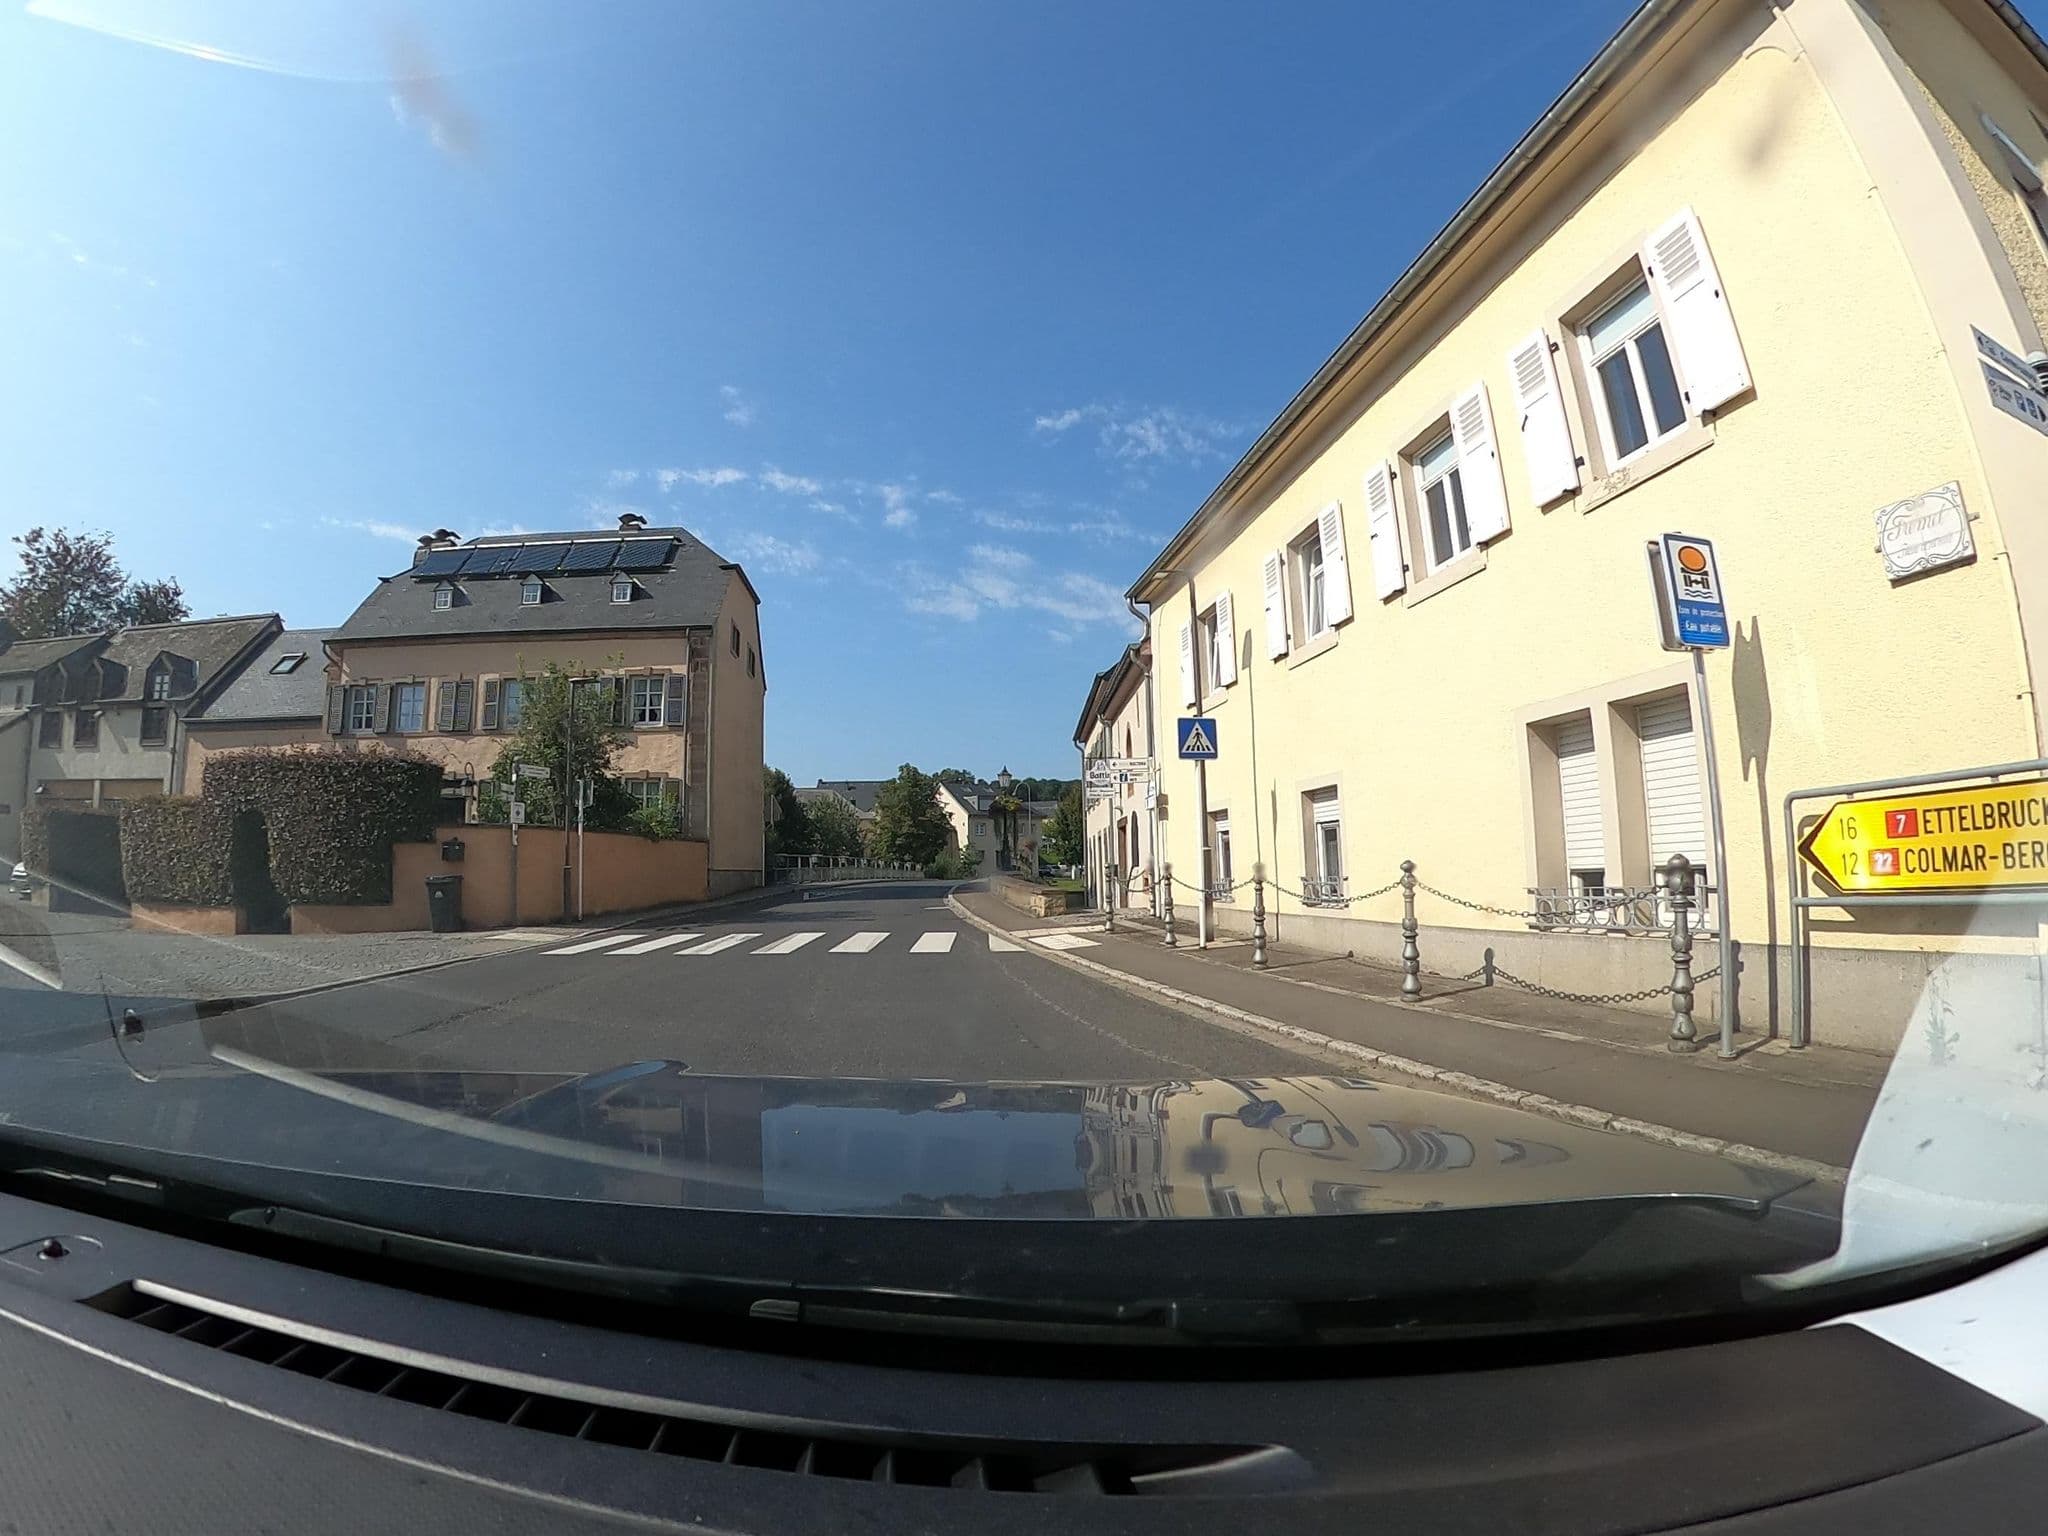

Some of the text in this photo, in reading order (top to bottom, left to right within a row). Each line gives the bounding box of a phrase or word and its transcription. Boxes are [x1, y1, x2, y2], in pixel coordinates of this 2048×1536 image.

[1840, 816, 1857, 840] 16
[1895, 814, 1907, 834] 7
[1842, 852, 1859, 876] 12
[1904, 840, 2048, 874] COLMAR-BER
